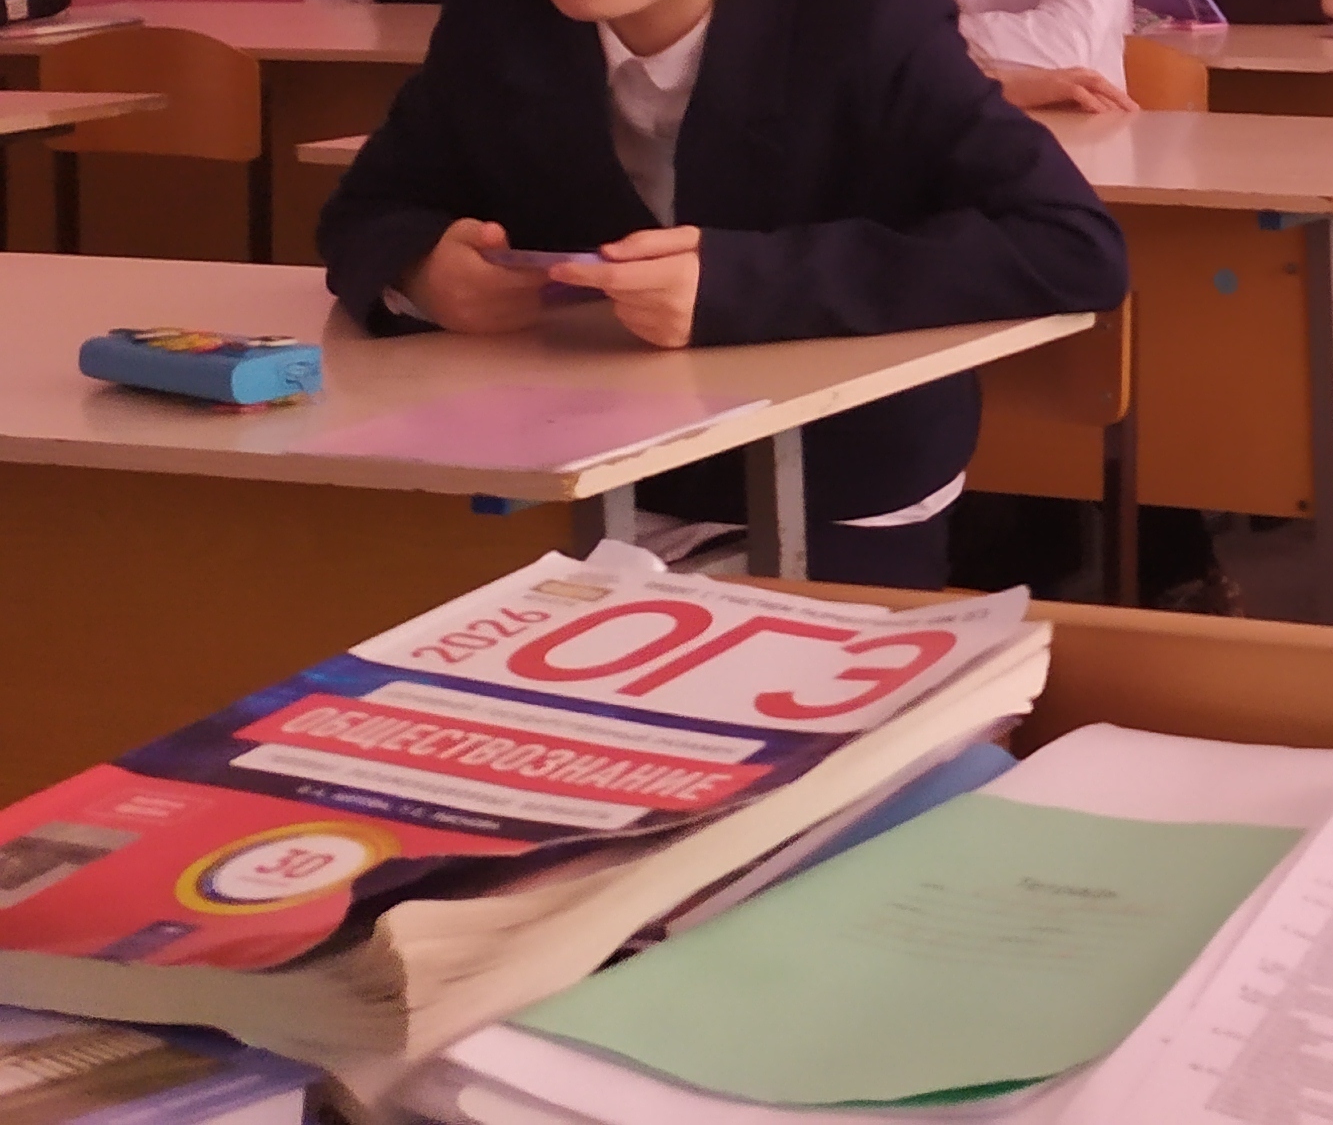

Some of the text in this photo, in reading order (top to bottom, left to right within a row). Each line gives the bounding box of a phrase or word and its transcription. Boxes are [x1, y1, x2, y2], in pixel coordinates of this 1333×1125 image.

[412, 607, 552, 664] 2026
[507, 599, 957, 721] ОГЭ
[281, 706, 735, 802] ОБЩЕСТВОЗНАНИЕ
[254, 847, 335, 879] 30
